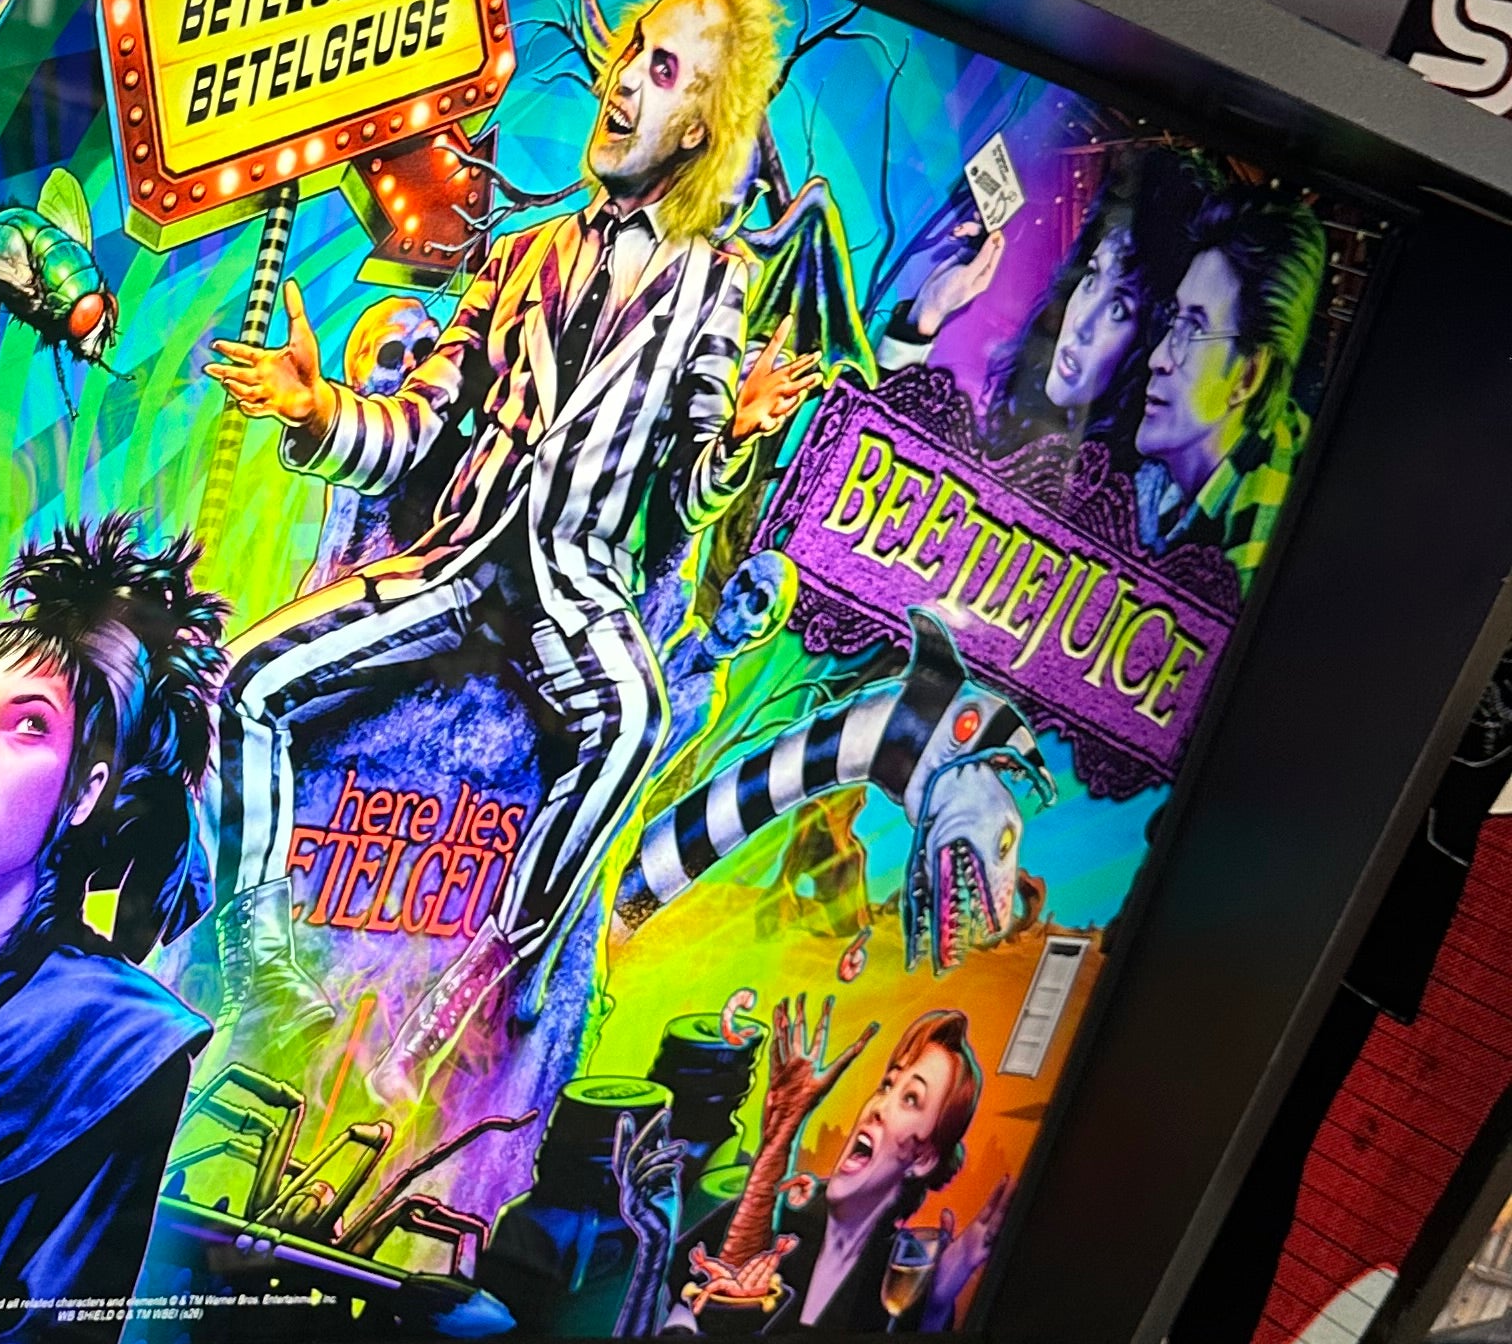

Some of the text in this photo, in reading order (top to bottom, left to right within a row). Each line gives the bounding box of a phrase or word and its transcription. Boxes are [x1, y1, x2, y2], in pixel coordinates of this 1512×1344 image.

[821, 433, 1206, 727] BEETLEJUICE
[330, 769, 524, 854] here lies
[20, 1297, 54, 1309] related
[56, 1296, 105, 1308] characters
[106, 1296, 125, 1307] and
[205, 1294, 238, 1306] Warner
[76, 1309, 113, 1322] SHIELD
